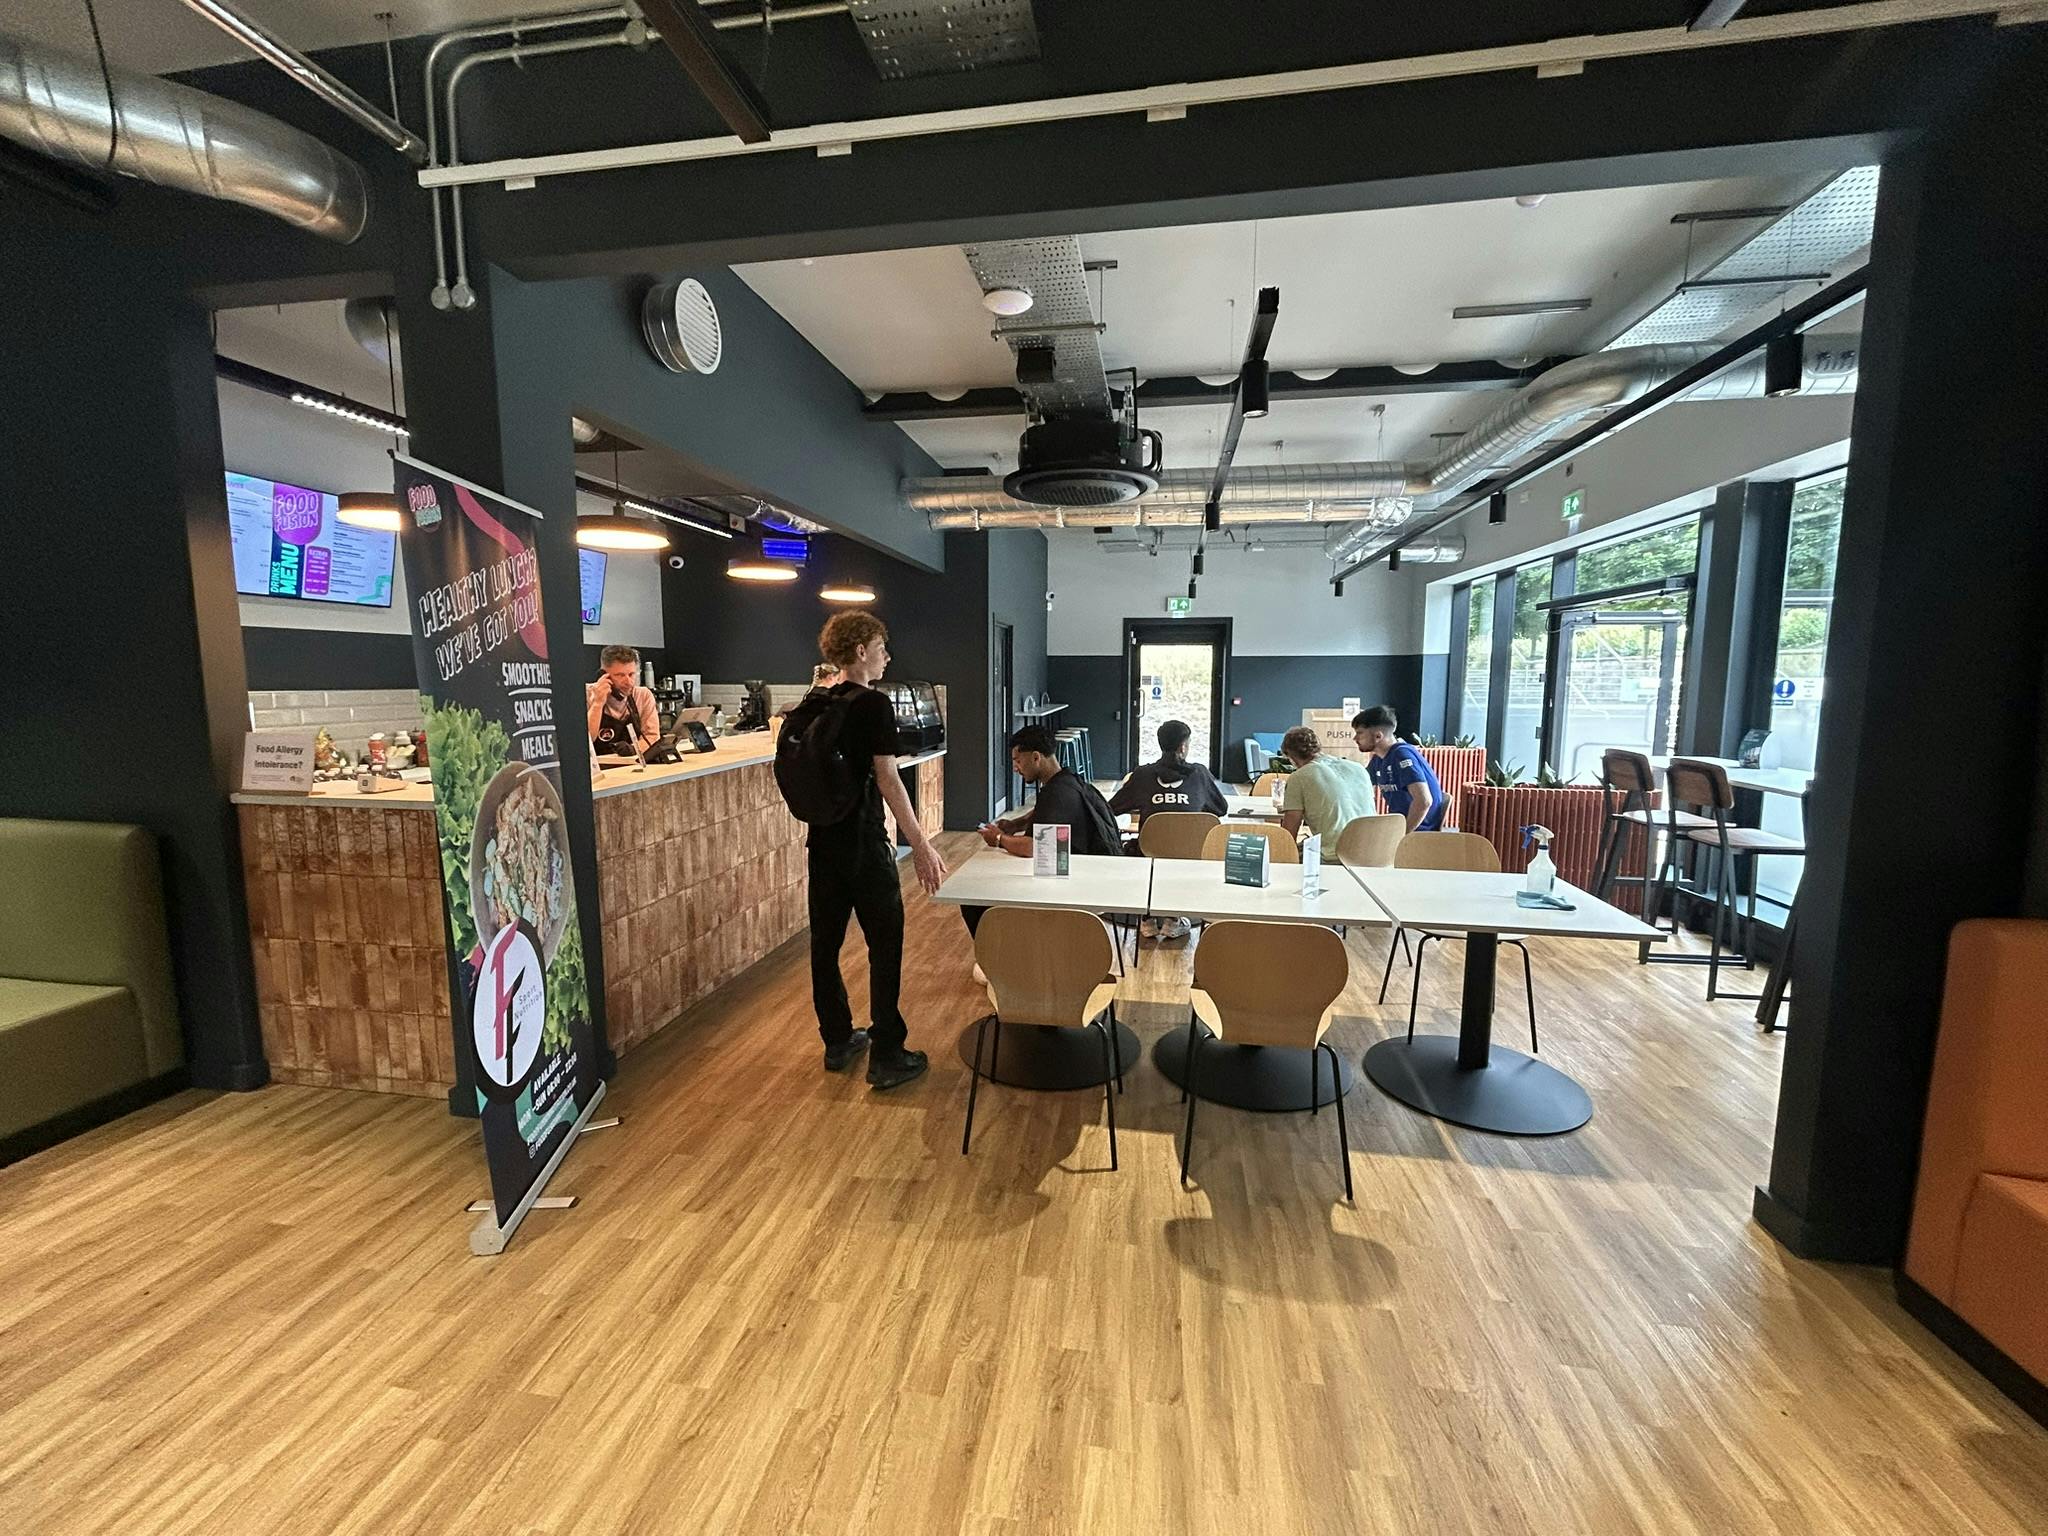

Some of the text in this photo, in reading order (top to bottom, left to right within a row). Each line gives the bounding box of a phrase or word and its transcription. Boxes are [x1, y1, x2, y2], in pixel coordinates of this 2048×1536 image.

[274, 492, 319, 517] FOOD
[408, 484, 437, 512] FOOD
[274, 512, 319, 532] FUSION
[270, 561, 281, 593] DRINKS
[280, 542, 300, 595] MENU
[419, 567, 488, 638] HEALTHY
[489, 546, 537, 601] LUNCH?
[435, 588, 539, 681] WE'VE GOT YOU!
[514, 698, 553, 725] SNACKS
[521, 733, 555, 761] MEALS
[1326, 730, 1352, 740] PUSH
[256, 744, 305, 756] Food Allergy
[254, 759, 304, 769] Intolerance?
[1151, 792, 1190, 805] GBR
[519, 984, 537, 1005] Sport
[533, 1052, 562, 1094] AVAILABLE
